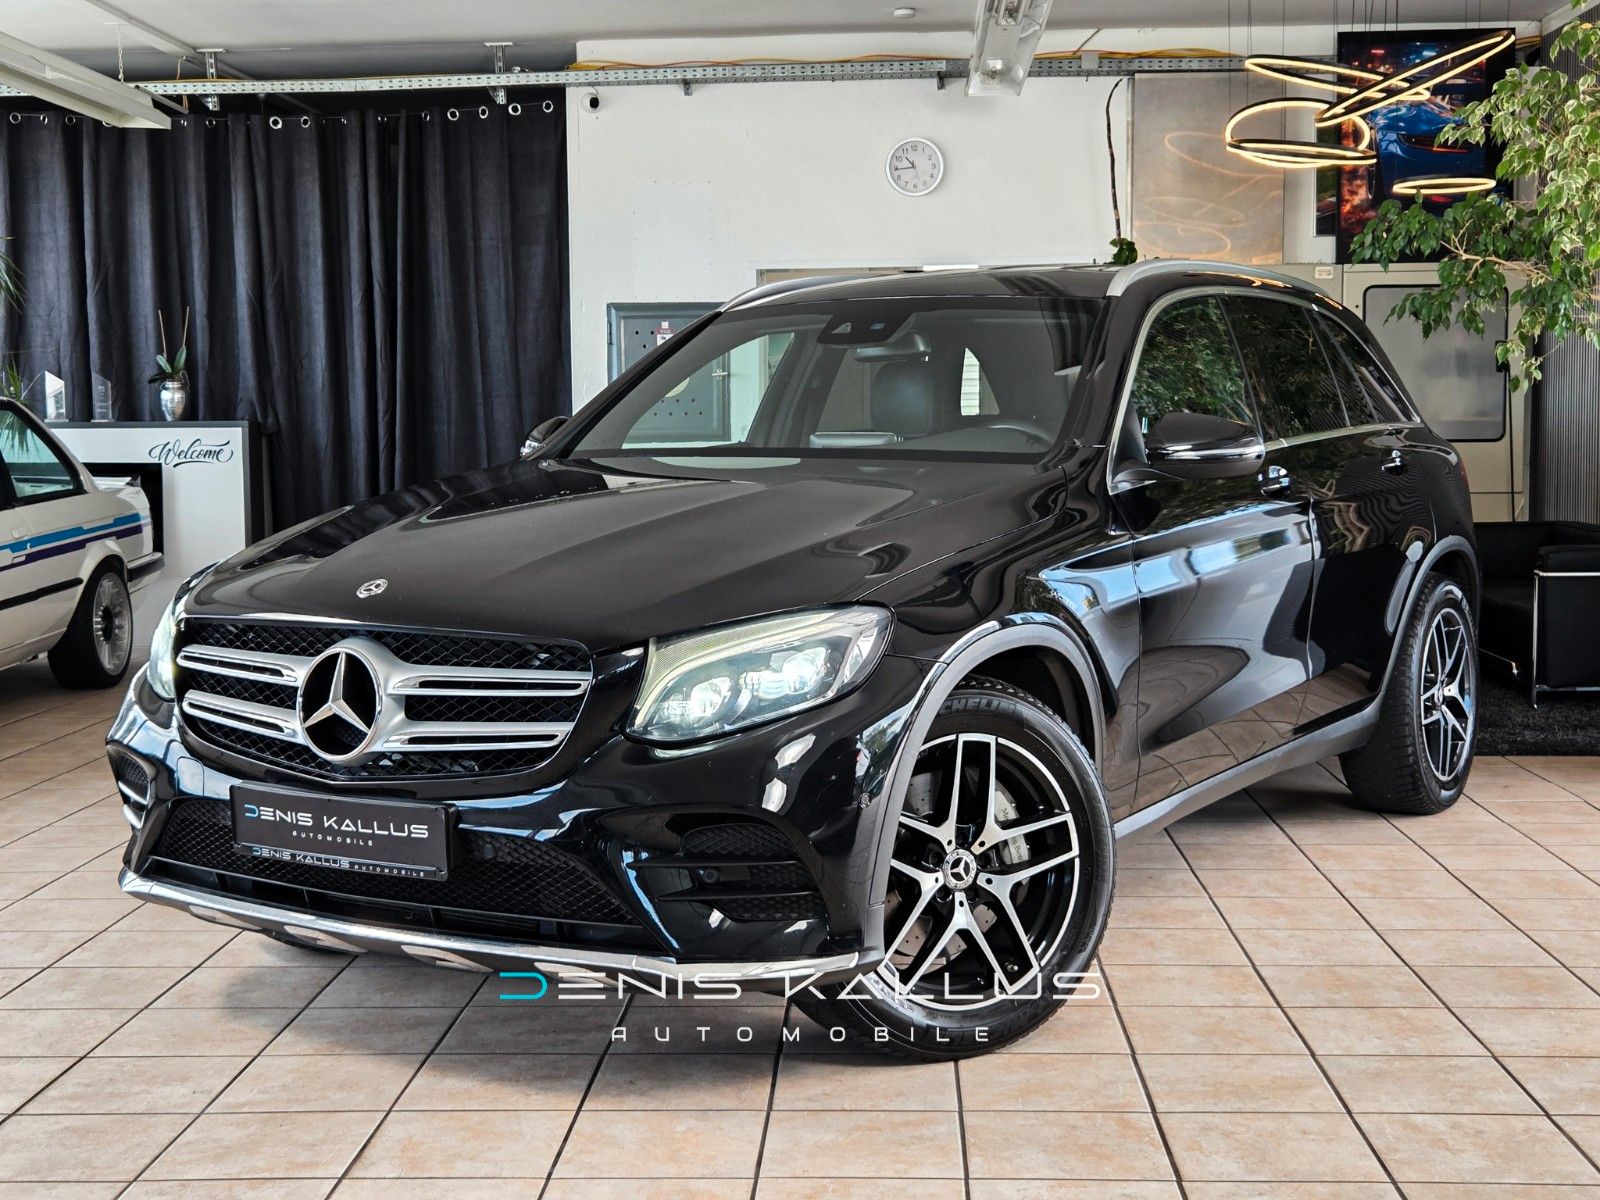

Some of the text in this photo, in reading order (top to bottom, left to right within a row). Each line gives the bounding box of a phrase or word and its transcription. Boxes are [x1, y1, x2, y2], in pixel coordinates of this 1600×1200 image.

[148, 438, 234, 467] Welcome
[938, 697, 1017, 715] CHELIN
[244, 803, 429, 839] DENIS KALLUS
[292, 831, 374, 846] AUTOMOBILE
[252, 847, 425, 877] DENIS KALLUS AUTOMOBILE
